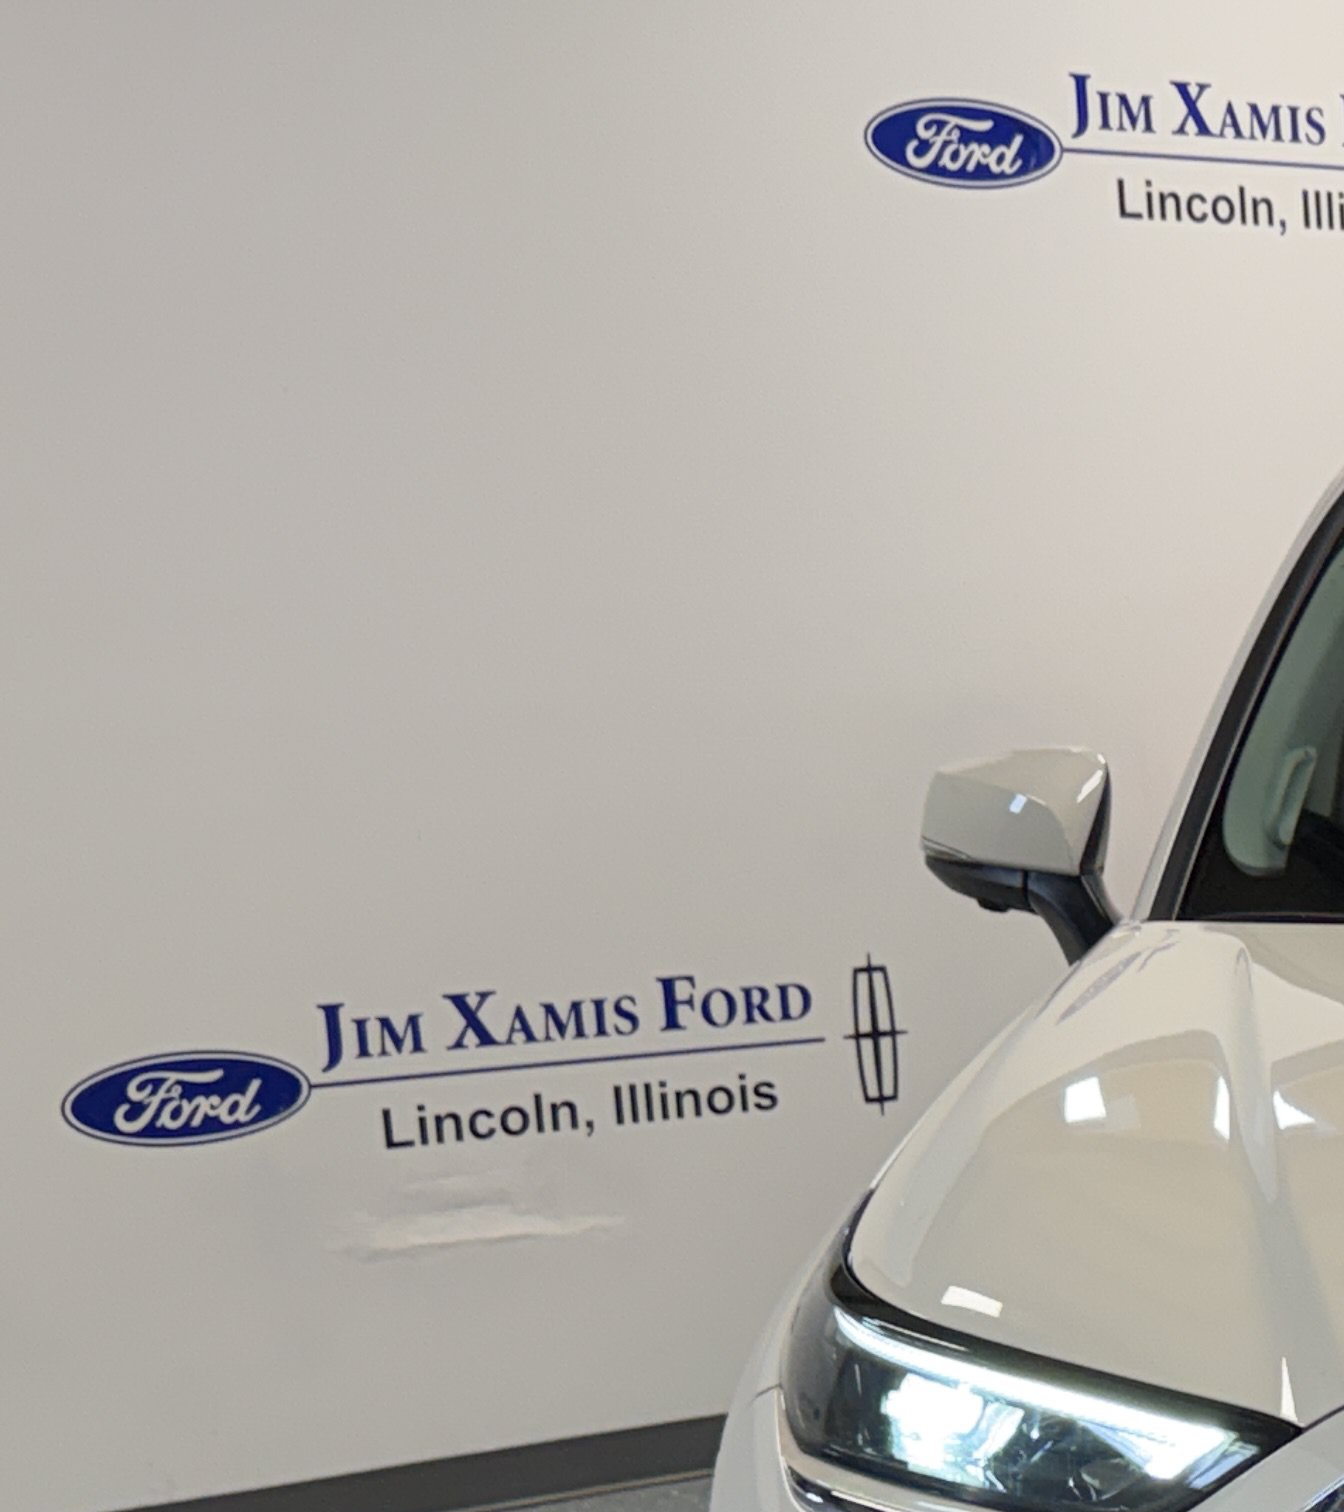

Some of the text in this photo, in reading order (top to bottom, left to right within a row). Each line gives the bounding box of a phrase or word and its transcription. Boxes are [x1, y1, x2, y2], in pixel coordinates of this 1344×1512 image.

[906, 113, 1023, 175] Ford
[1068, 73, 1155, 138] JIM
[1170, 80, 1325, 146] XAMIS
[1117, 179, 1287, 237] Lincoln,
[316, 975, 813, 1073] JIM XAMIS FORD
[113, 1069, 262, 1134] Ford
[381, 1074, 779, 1150] Lincoln, Illinois
